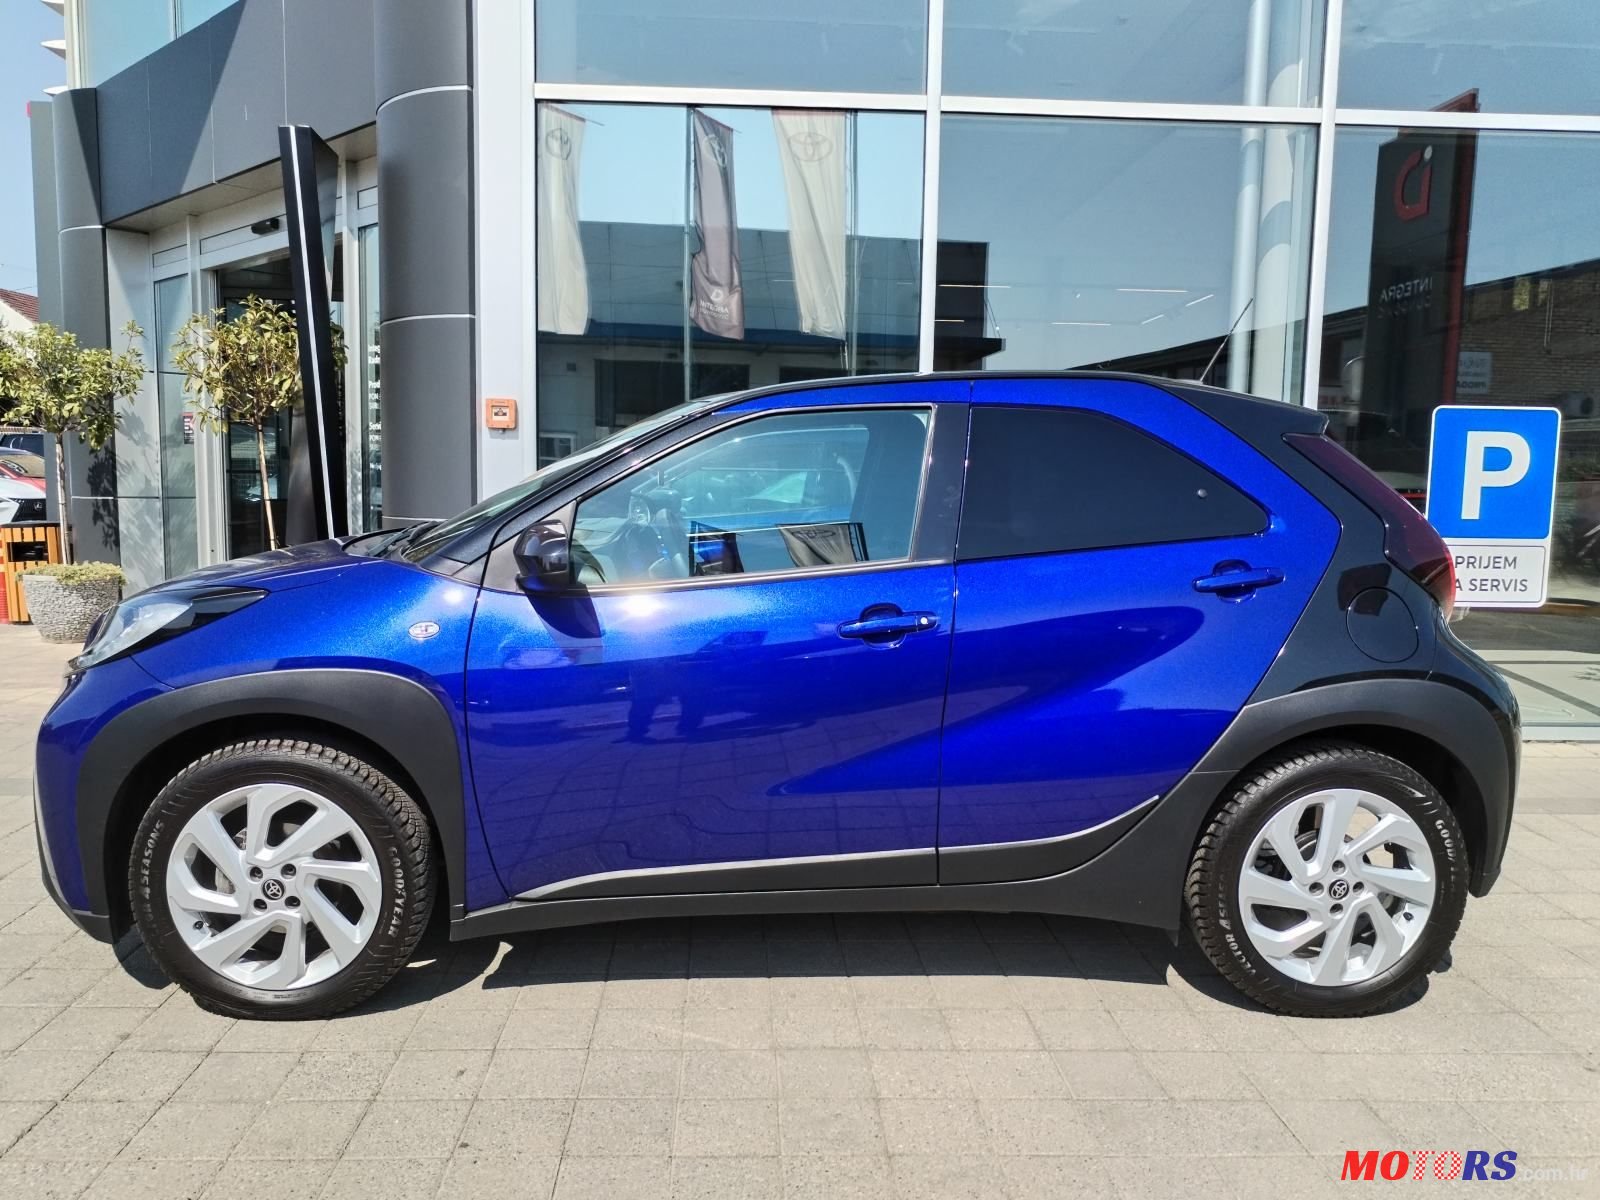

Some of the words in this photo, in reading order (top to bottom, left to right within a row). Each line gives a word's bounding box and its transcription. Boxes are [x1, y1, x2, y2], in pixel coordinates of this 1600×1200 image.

[1461, 431, 1531, 520] P
[1455, 556, 1518, 569] PRIJEM
[1468, 578, 1528, 592] SERVIS
